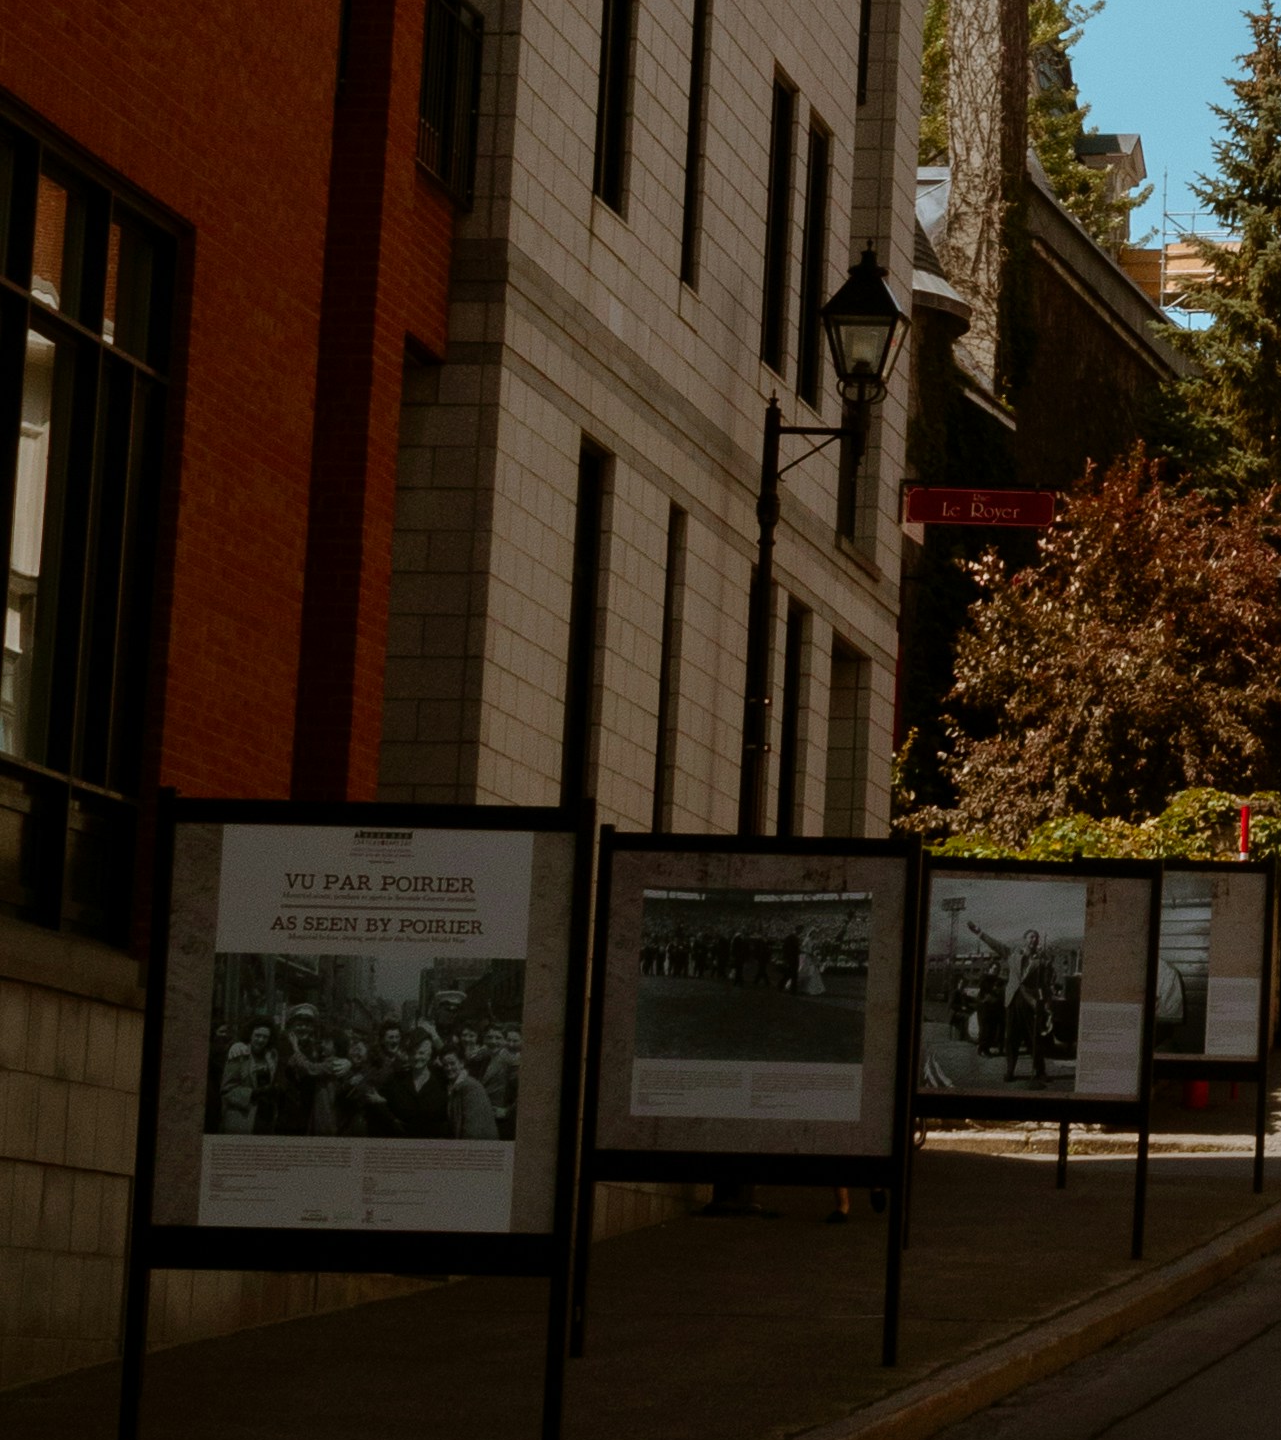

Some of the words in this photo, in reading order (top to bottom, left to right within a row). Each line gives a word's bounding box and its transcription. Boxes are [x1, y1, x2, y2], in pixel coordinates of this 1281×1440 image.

[942, 501, 961, 518] Le
[970, 502, 1021, 523] Royer
[284, 873, 316, 890] VU
[323, 874, 373, 891] PAR
[380, 875, 475, 894] POIRIER
[270, 916, 297, 931] AS
[303, 916, 359, 932] SEEN
[366, 917, 393, 933] BY
[398, 918, 484, 935] POIRIER
